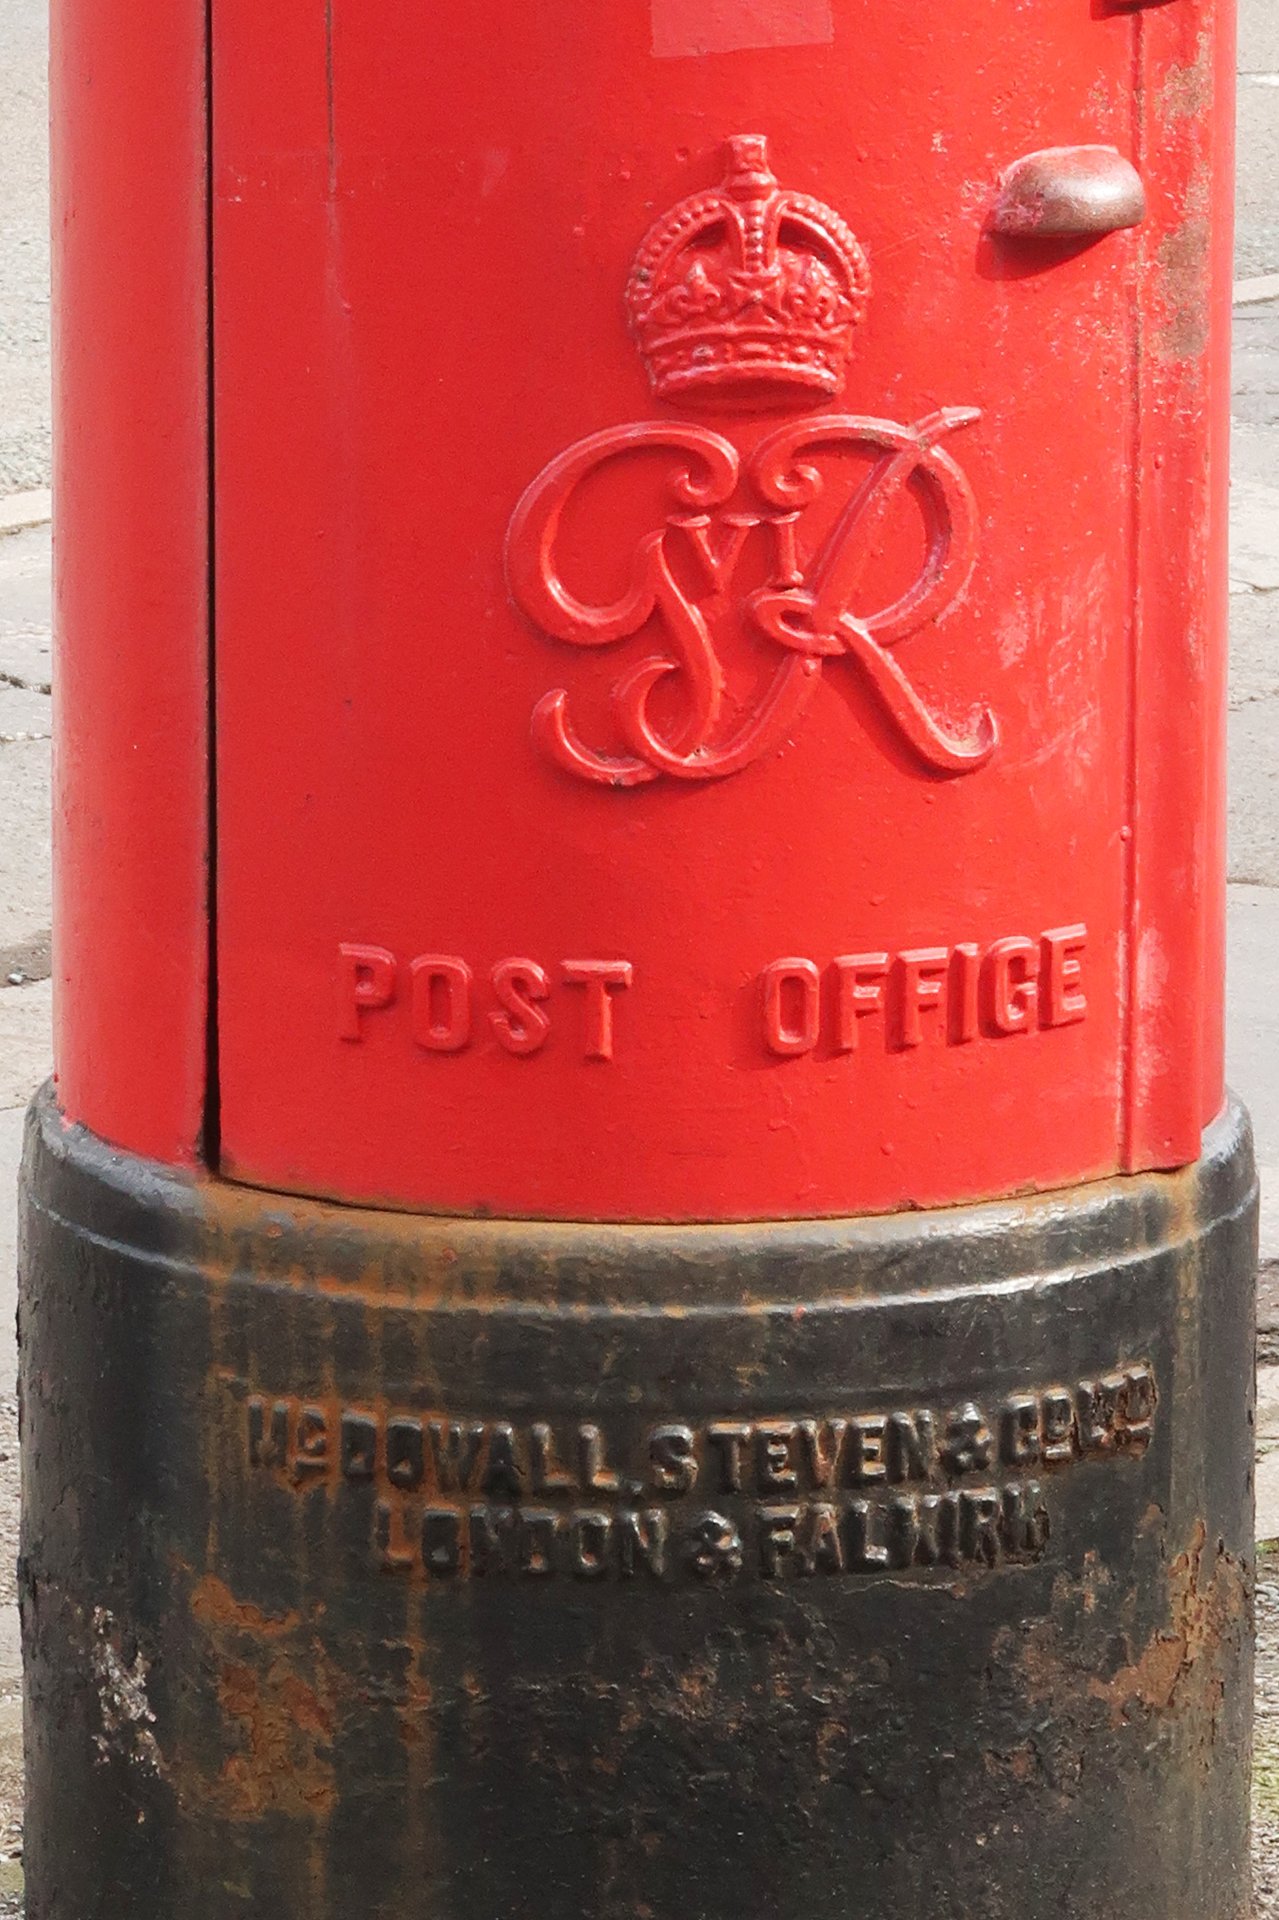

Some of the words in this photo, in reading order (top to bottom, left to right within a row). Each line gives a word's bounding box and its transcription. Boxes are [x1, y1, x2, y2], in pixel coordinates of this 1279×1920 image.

[339, 941, 633, 1064] POST
[762, 923, 1088, 1057] OFFICE
[648, 1409, 938, 1492] STEVEN
[942, 1402, 992, 1474] &
[376, 1500, 666, 1578] LONDON
[697, 1508, 744, 1578] &
[755, 1478, 1050, 1578] FALKIRK
